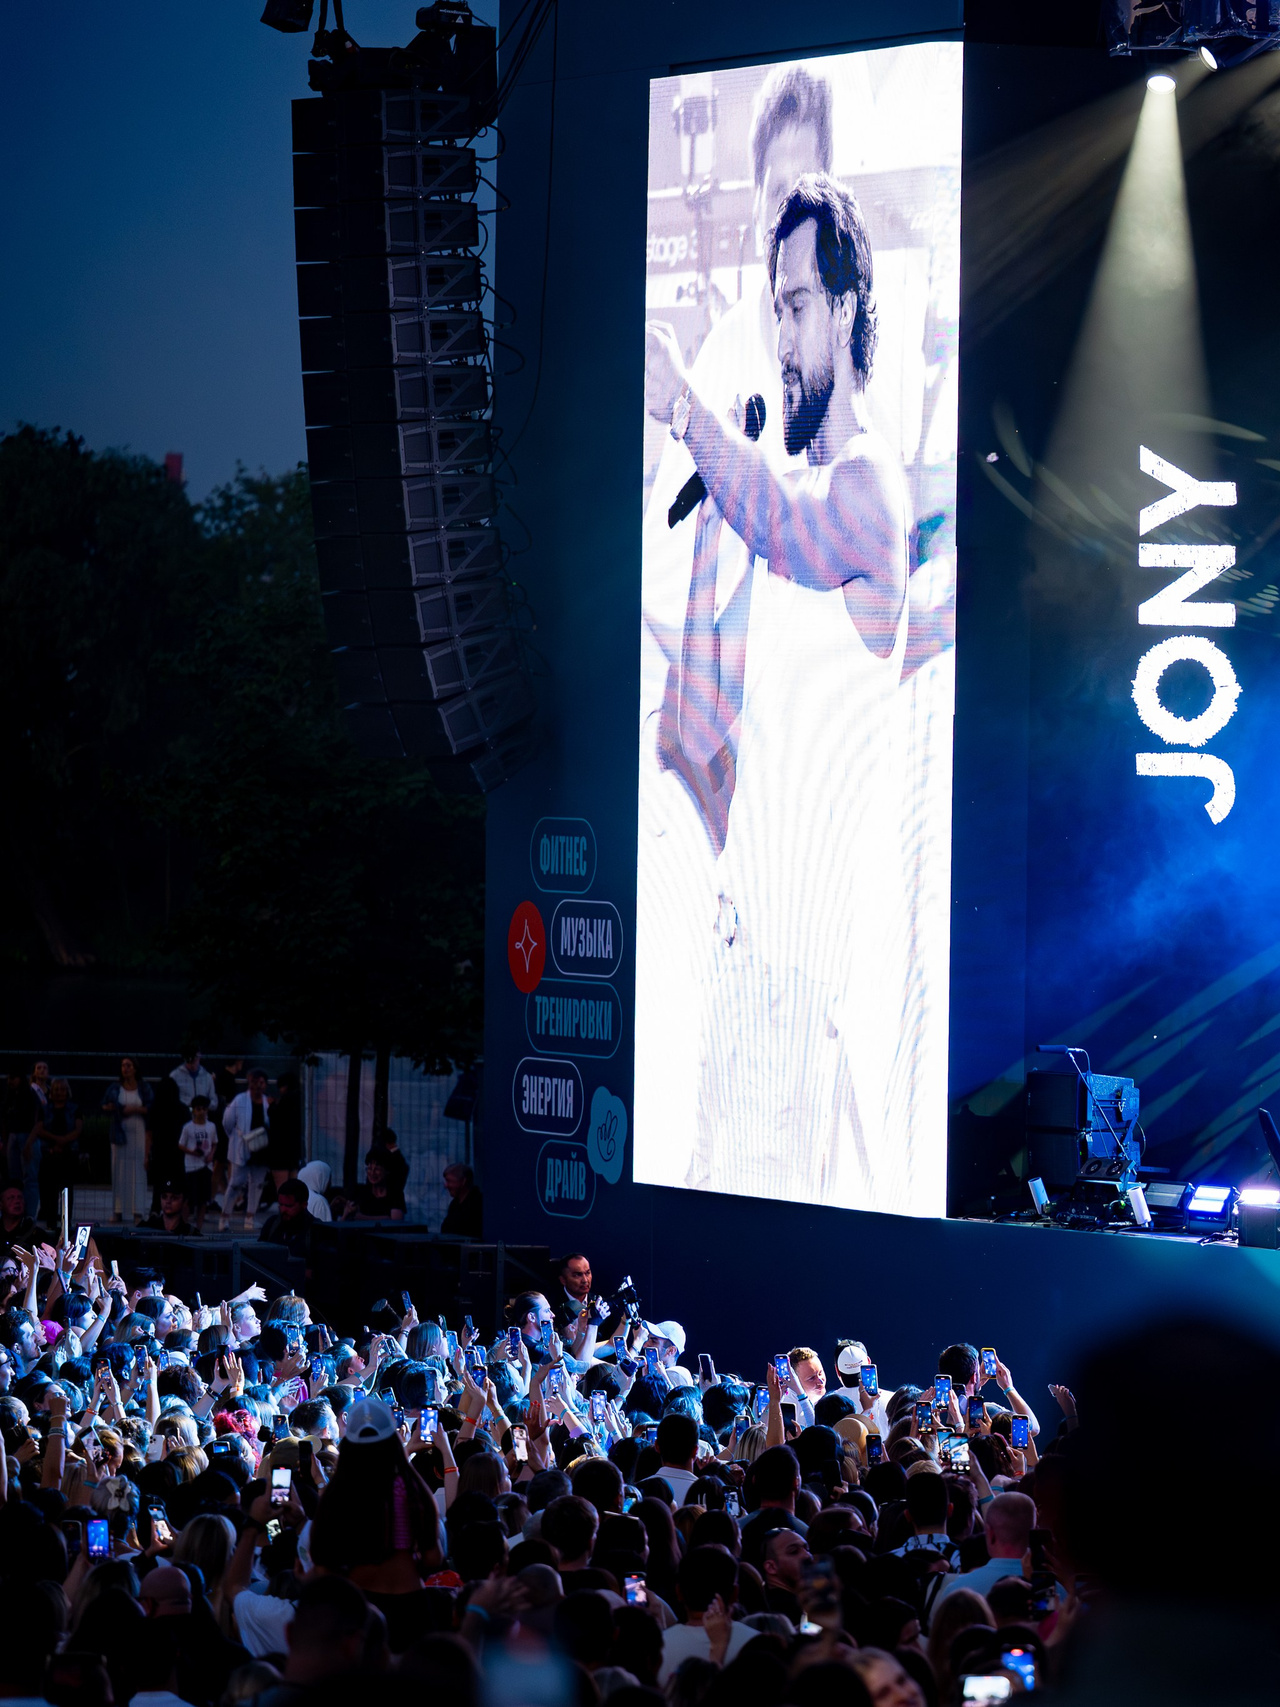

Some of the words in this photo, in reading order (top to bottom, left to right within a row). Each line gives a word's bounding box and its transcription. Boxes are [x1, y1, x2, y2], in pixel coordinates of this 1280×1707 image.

[1131, 444, 1243, 825] JONY
[539, 834, 587, 876] ФИТНЕС
[560, 917, 613, 959] МУЗЫКА
[535, 996, 612, 1041] ТРЕНИРОВКИ
[522, 1074, 574, 1119] ЭНЕРГИЯ
[545, 1152, 586, 1202] ДРАЙВ
